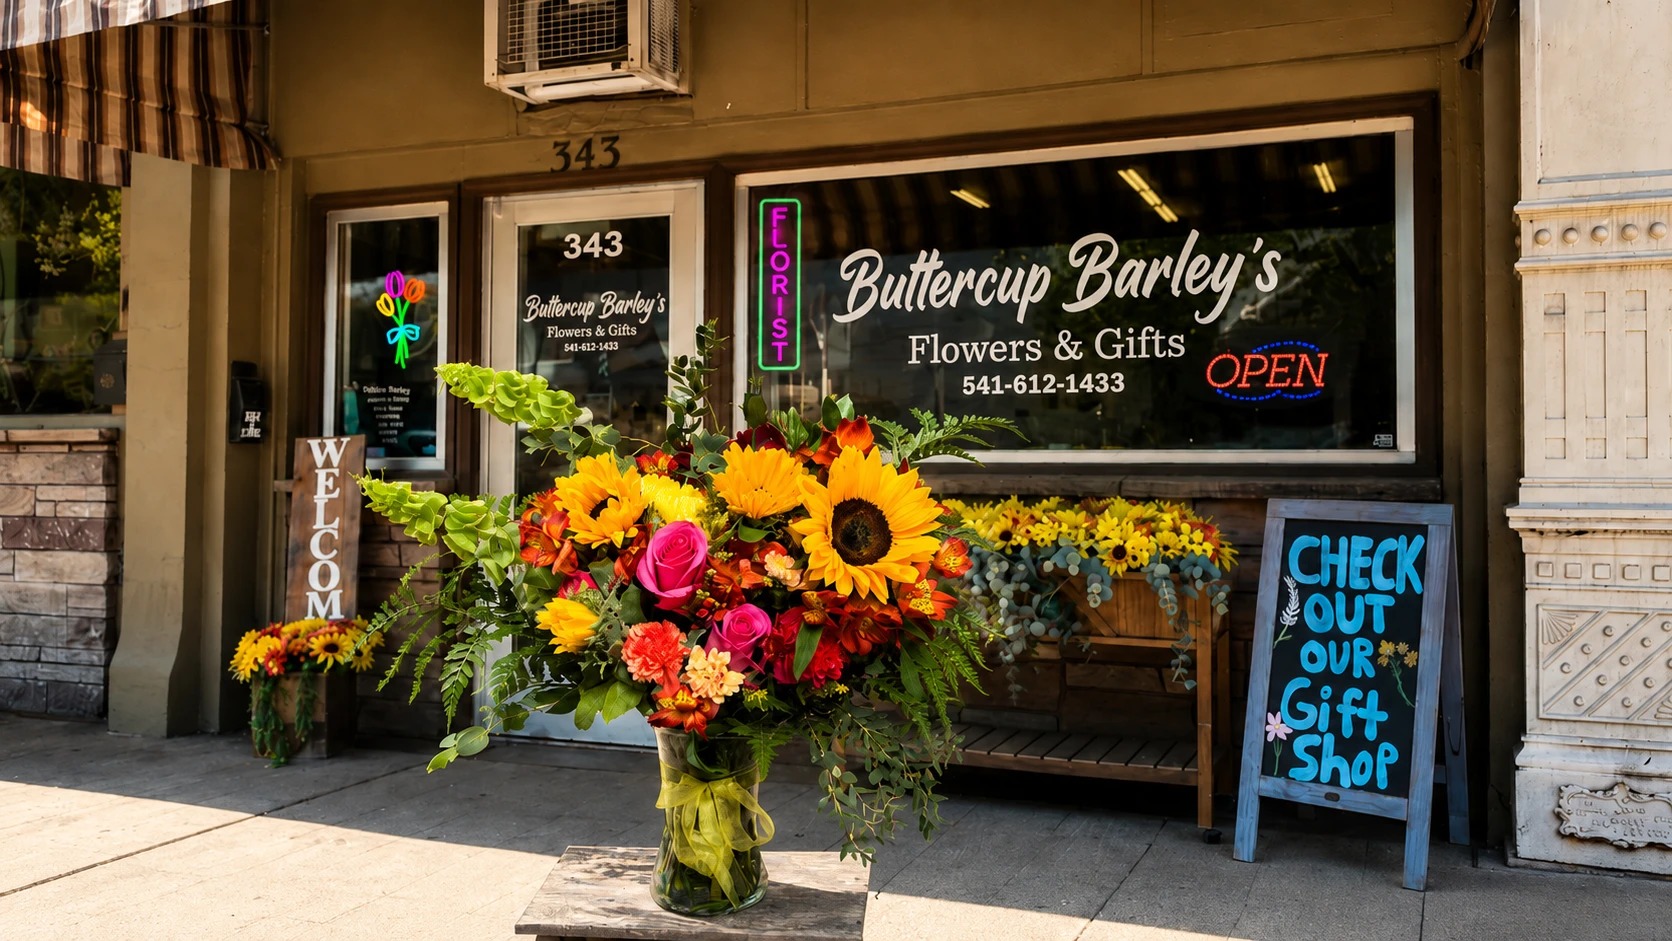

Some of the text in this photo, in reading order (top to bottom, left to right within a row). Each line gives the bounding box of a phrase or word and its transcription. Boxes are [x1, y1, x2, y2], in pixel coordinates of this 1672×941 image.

[550, 135, 620, 172] 343
[563, 230, 623, 259] 343
[769, 206, 790, 362] FLORIST
[833, 228, 1282, 325] Buttercup Barley's
[523, 290, 667, 325] Buttercup Barley's
[547, 323, 638, 338] Flowers & Gifts
[564, 341, 619, 352] 541-612-1433
[907, 325, 1186, 365] Flowers & Gifts
[962, 372, 1125, 396] 541-612-1433
[1206, 352, 1329, 389] OPEN
[304, 438, 348, 620] WELCOM
[1288, 534, 1425, 595] CHECK
[1303, 593, 1396, 635] OUT
[1299, 637, 1376, 679] OUR
[1279, 676, 1388, 742] Gift
[1288, 733, 1399, 789] Shop
